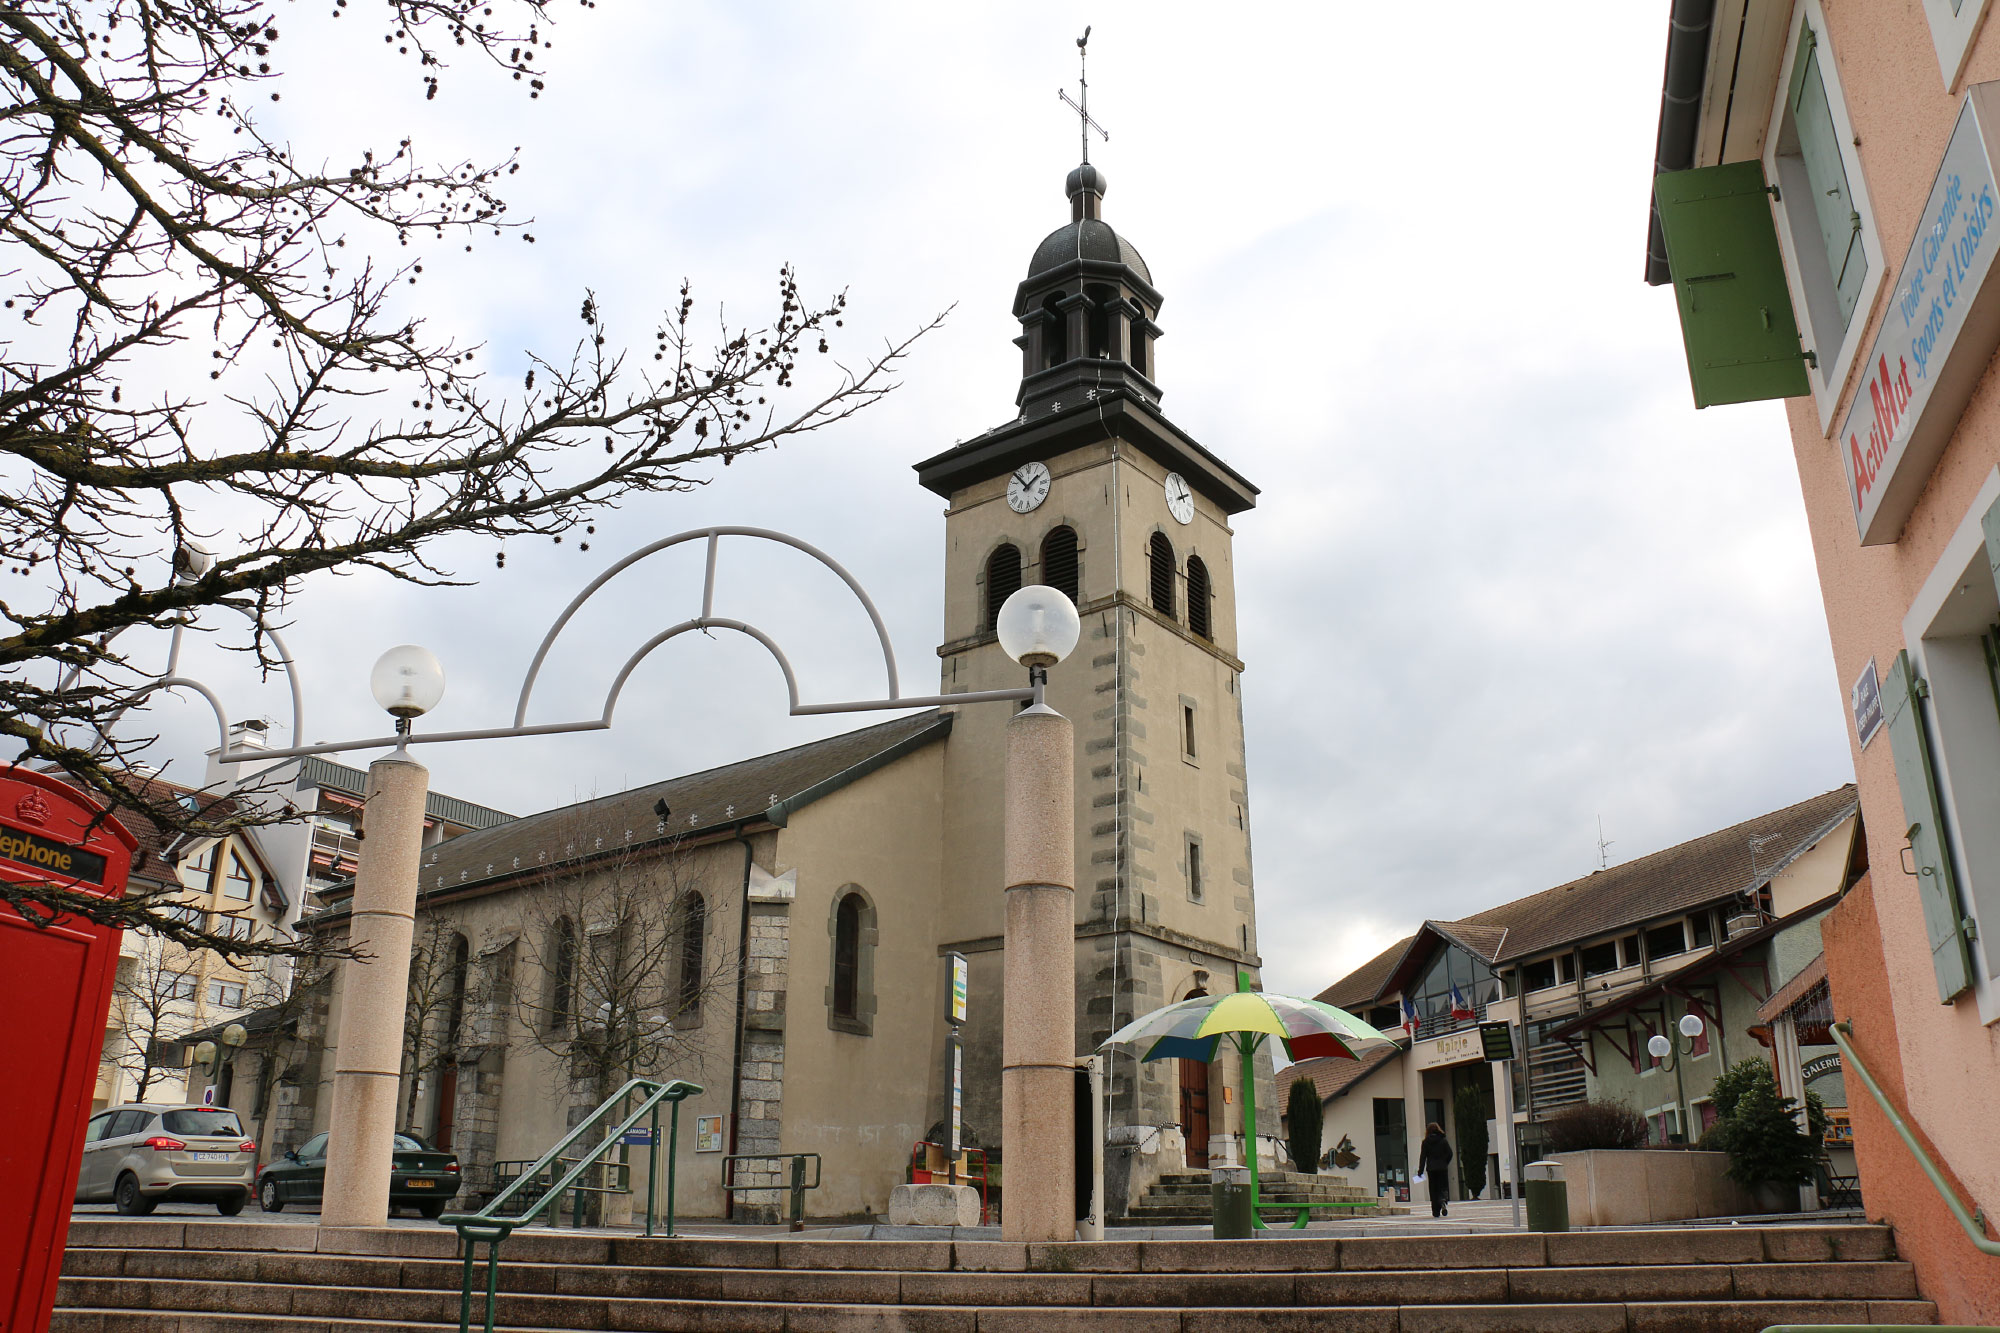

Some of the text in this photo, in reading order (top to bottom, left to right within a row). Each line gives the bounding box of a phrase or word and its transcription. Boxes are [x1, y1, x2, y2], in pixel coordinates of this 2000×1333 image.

[1900, 173, 1963, 329] Votre Garantie
[1912, 183, 1994, 380] Sports et Loisirs
[1850, 352, 1913, 513] ActiMut
[0, 828, 72, 871] ephone
[1436, 1037, 1468, 1054] Mairie
[1802, 1057, 1841, 1079] GALERIE
